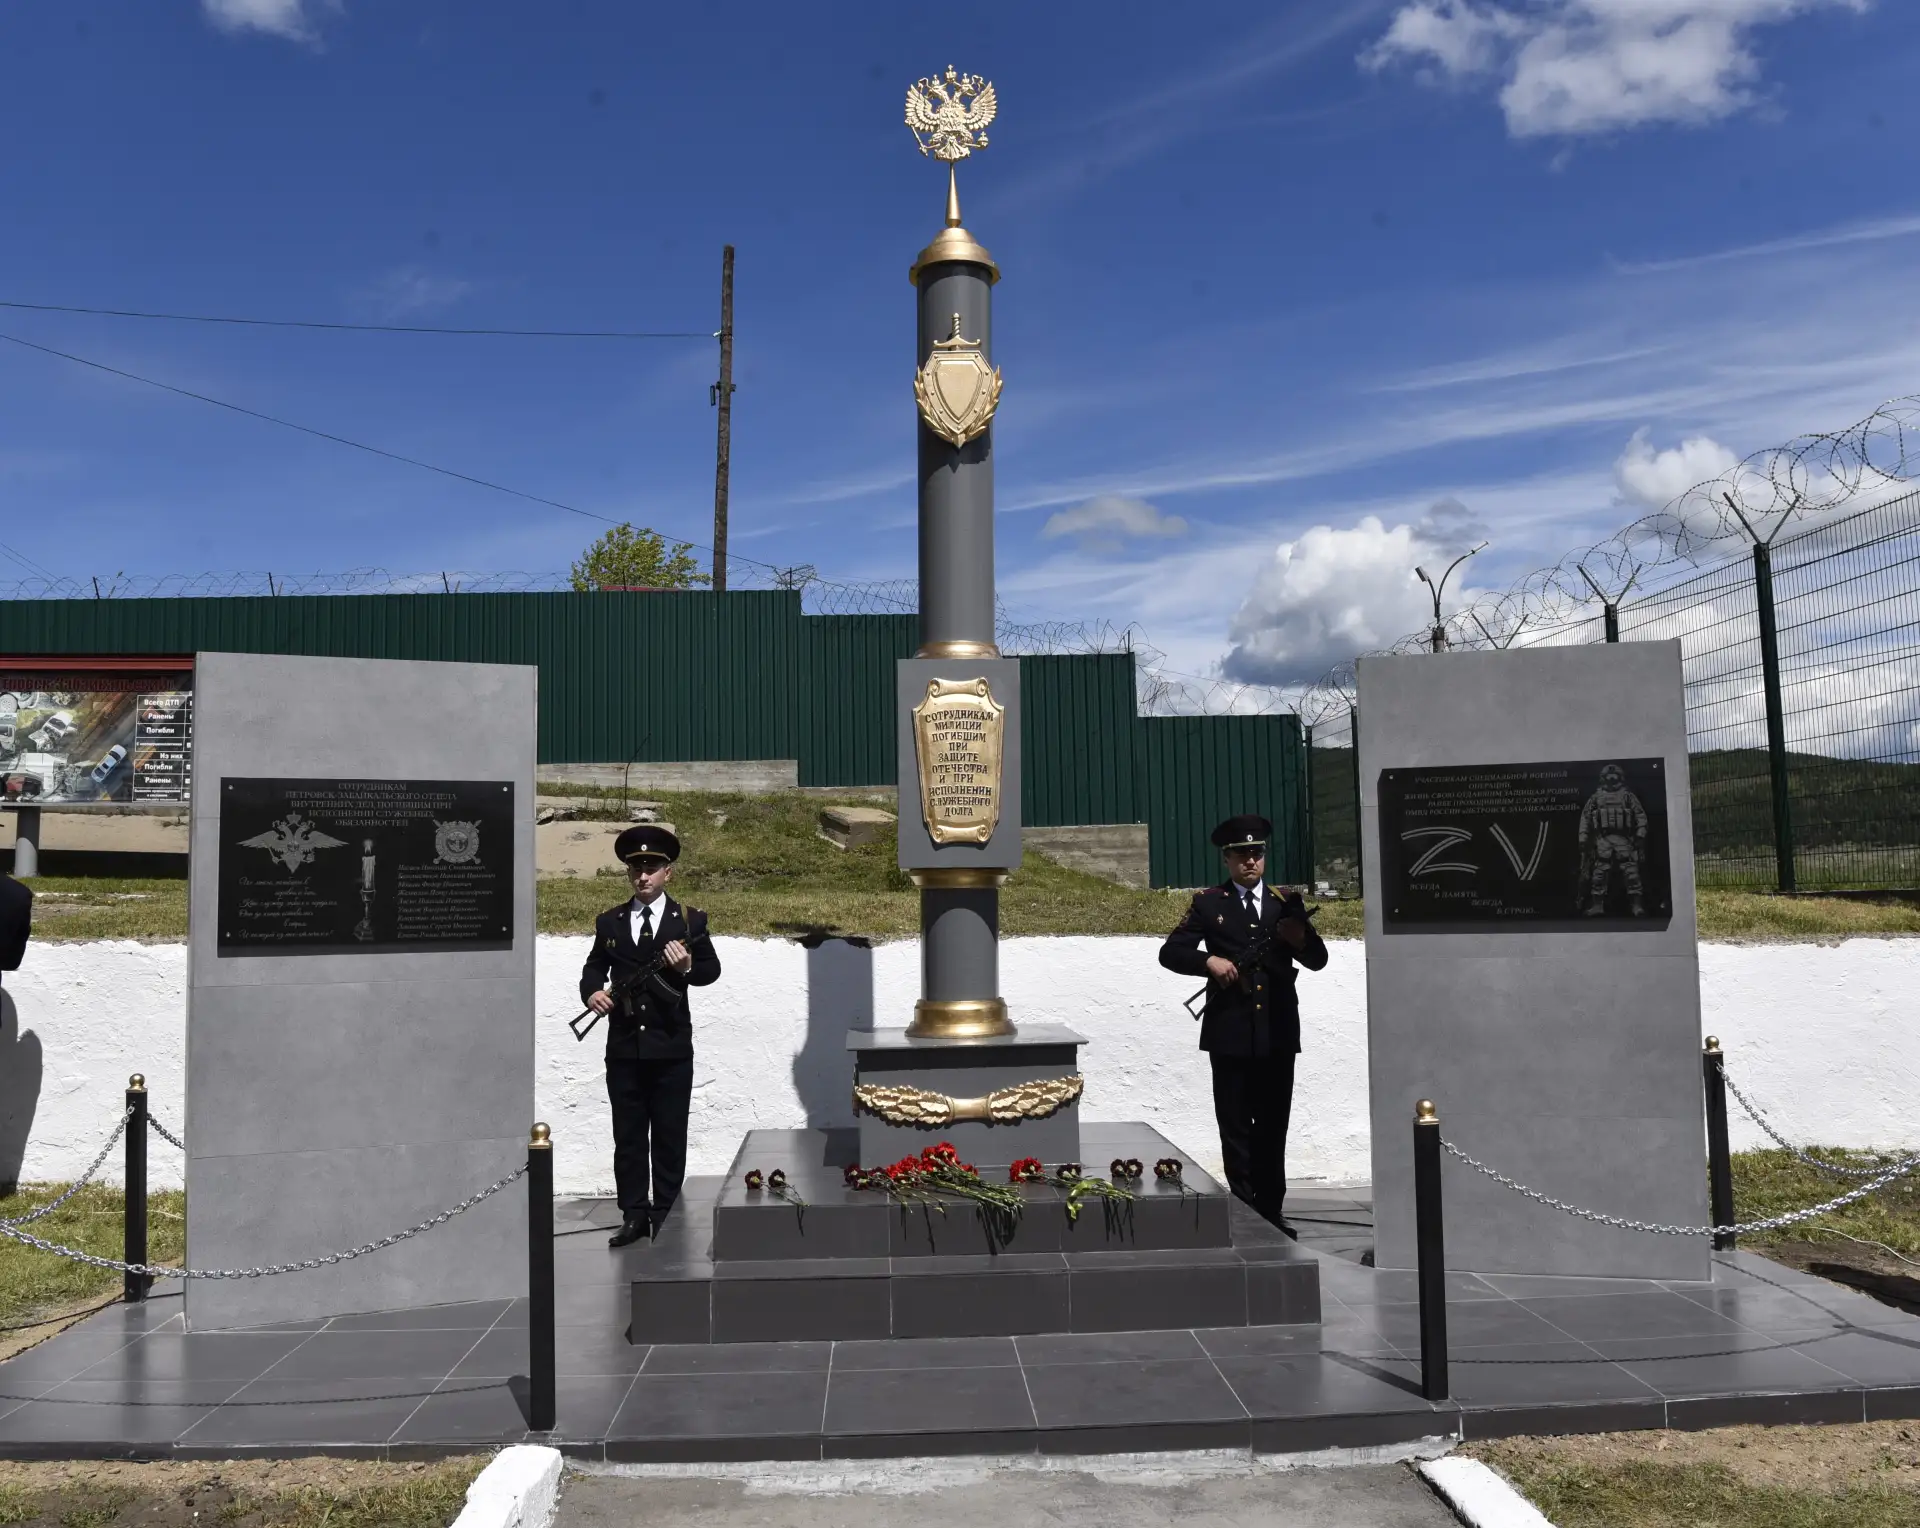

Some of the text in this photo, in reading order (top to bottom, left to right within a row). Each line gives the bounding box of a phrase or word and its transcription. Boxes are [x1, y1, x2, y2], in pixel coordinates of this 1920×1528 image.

[165, 699, 180, 707] ДТП
[925, 710, 994, 723] СОТРУДНИКАМ
[935, 721, 982, 731] МИЛИЦИИ
[932, 732, 986, 742] ПОГИБШИМ
[949, 742, 968, 751] ПРИ
[938, 752, 979, 763] ЗАЩИТЕ
[932, 763, 988, 774] ОТЕЧЕСТВА
[939, 773, 974, 784] И ПРИ
[1469, 774, 1527, 782] СПЕЦИАЛЬНОЙ
[1530, 770, 1568, 779] ВОЕННОЙ
[339, 783, 407, 791] СОТРУДНИКАМ
[928, 786, 992, 796] ИСПОЛНЕНИИ
[1457, 791, 1502, 799] ОТДАВШИМ
[1504, 789, 1545, 797] ЗАЩИЩАЯ
[291, 800, 353, 808] ВНУТРЕННИХ
[377, 801, 431, 809] ПОГИБШИМ
[930, 796, 990, 807] СЛУЖЕБНОГО
[376, 810, 434, 818] СЛУЖЕБНЫХ
[944, 807, 973, 817] ДОЛГА
[336, 818, 409, 827] ОБЯЗАННОСТЕЙ
[1401, 821, 1549, 880] Z V
